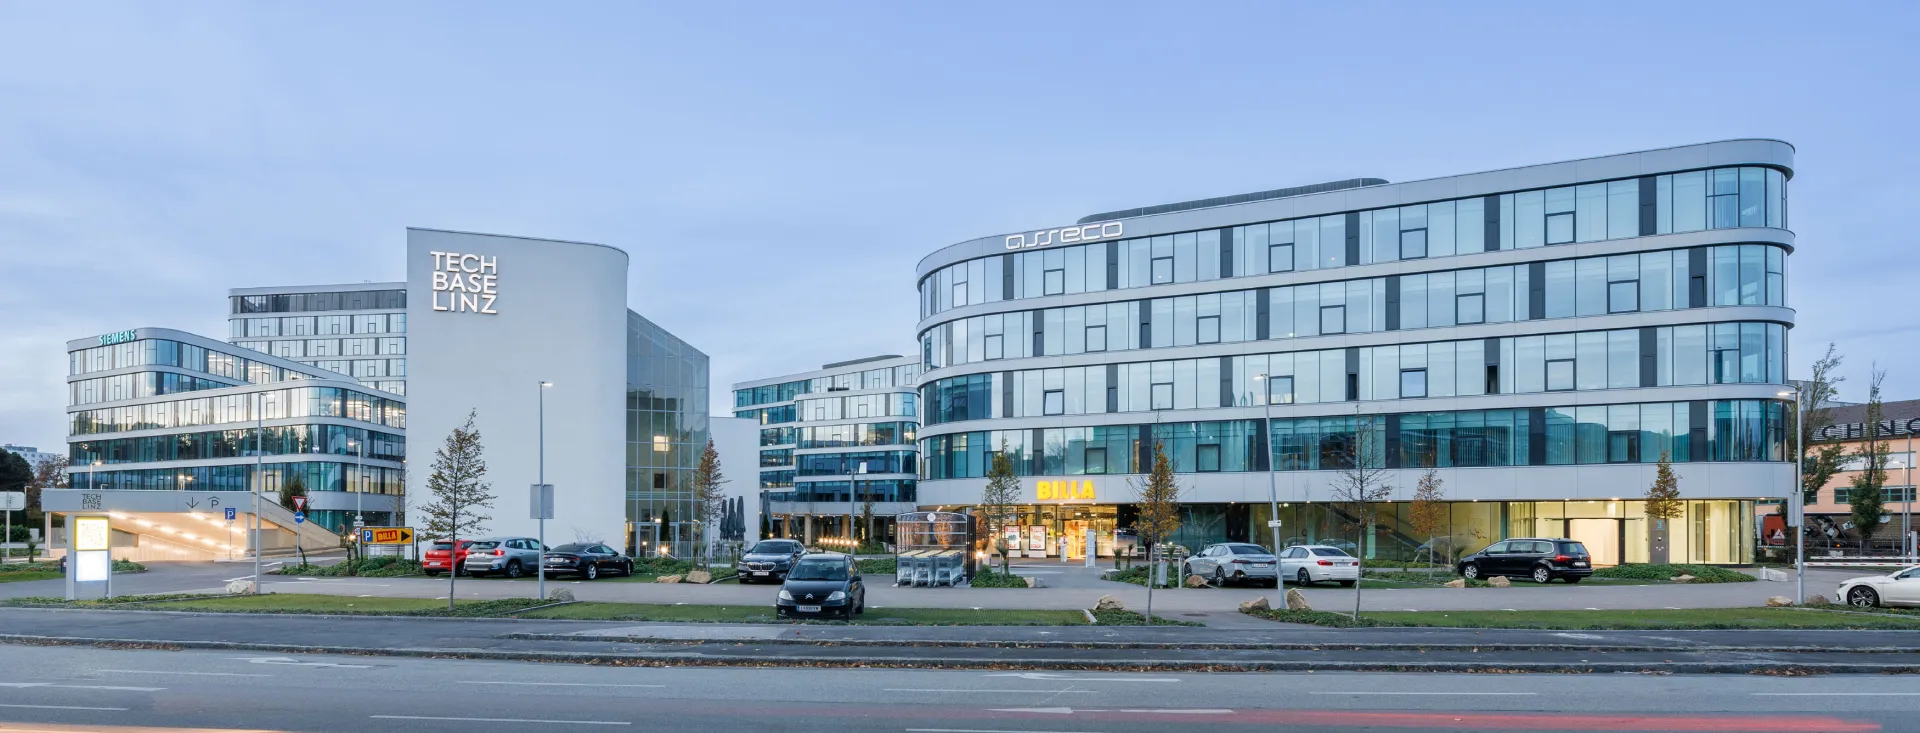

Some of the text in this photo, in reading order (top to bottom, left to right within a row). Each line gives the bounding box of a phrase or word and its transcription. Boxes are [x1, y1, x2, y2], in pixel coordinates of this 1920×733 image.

[1005, 221, 1123, 250] asseco
[430, 251, 497, 275] TECH
[433, 271, 497, 295] BASE
[433, 291, 497, 314] LINZ
[99, 329, 136, 346] SIEMENS
[1037, 480, 1096, 500] BILLA
[211, 500, 220, 509] P
[365, 530, 371, 541] P
[377, 531, 397, 541] BILLA
